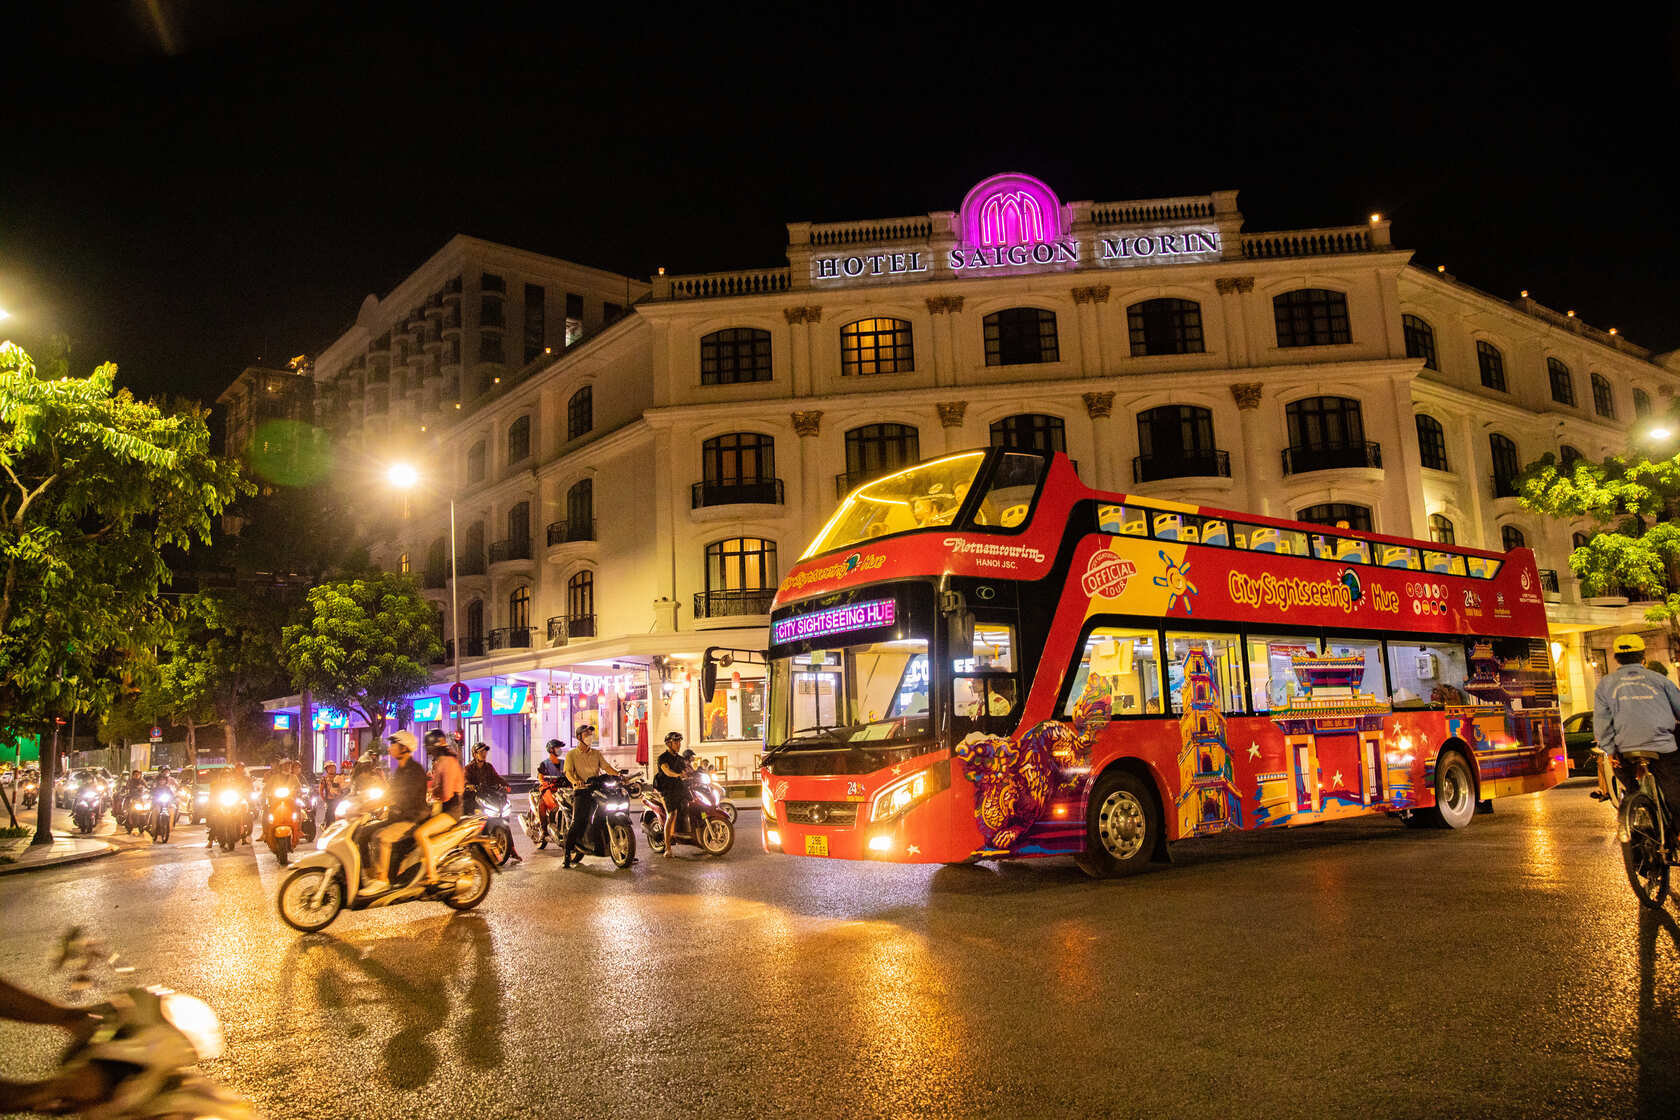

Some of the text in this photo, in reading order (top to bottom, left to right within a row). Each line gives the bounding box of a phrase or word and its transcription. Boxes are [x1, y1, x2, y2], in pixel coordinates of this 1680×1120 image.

[816, 231, 1219, 279] HOTEL SAIGON MORIN
[975, 558, 1001, 568] HANOI
[1087, 562, 1135, 590] OFFICIAL
[1105, 580, 1126, 596] TOUR
[1370, 582, 1400, 614] Hue
[778, 603, 894, 639] CITY SIGHTSEEING HUE
